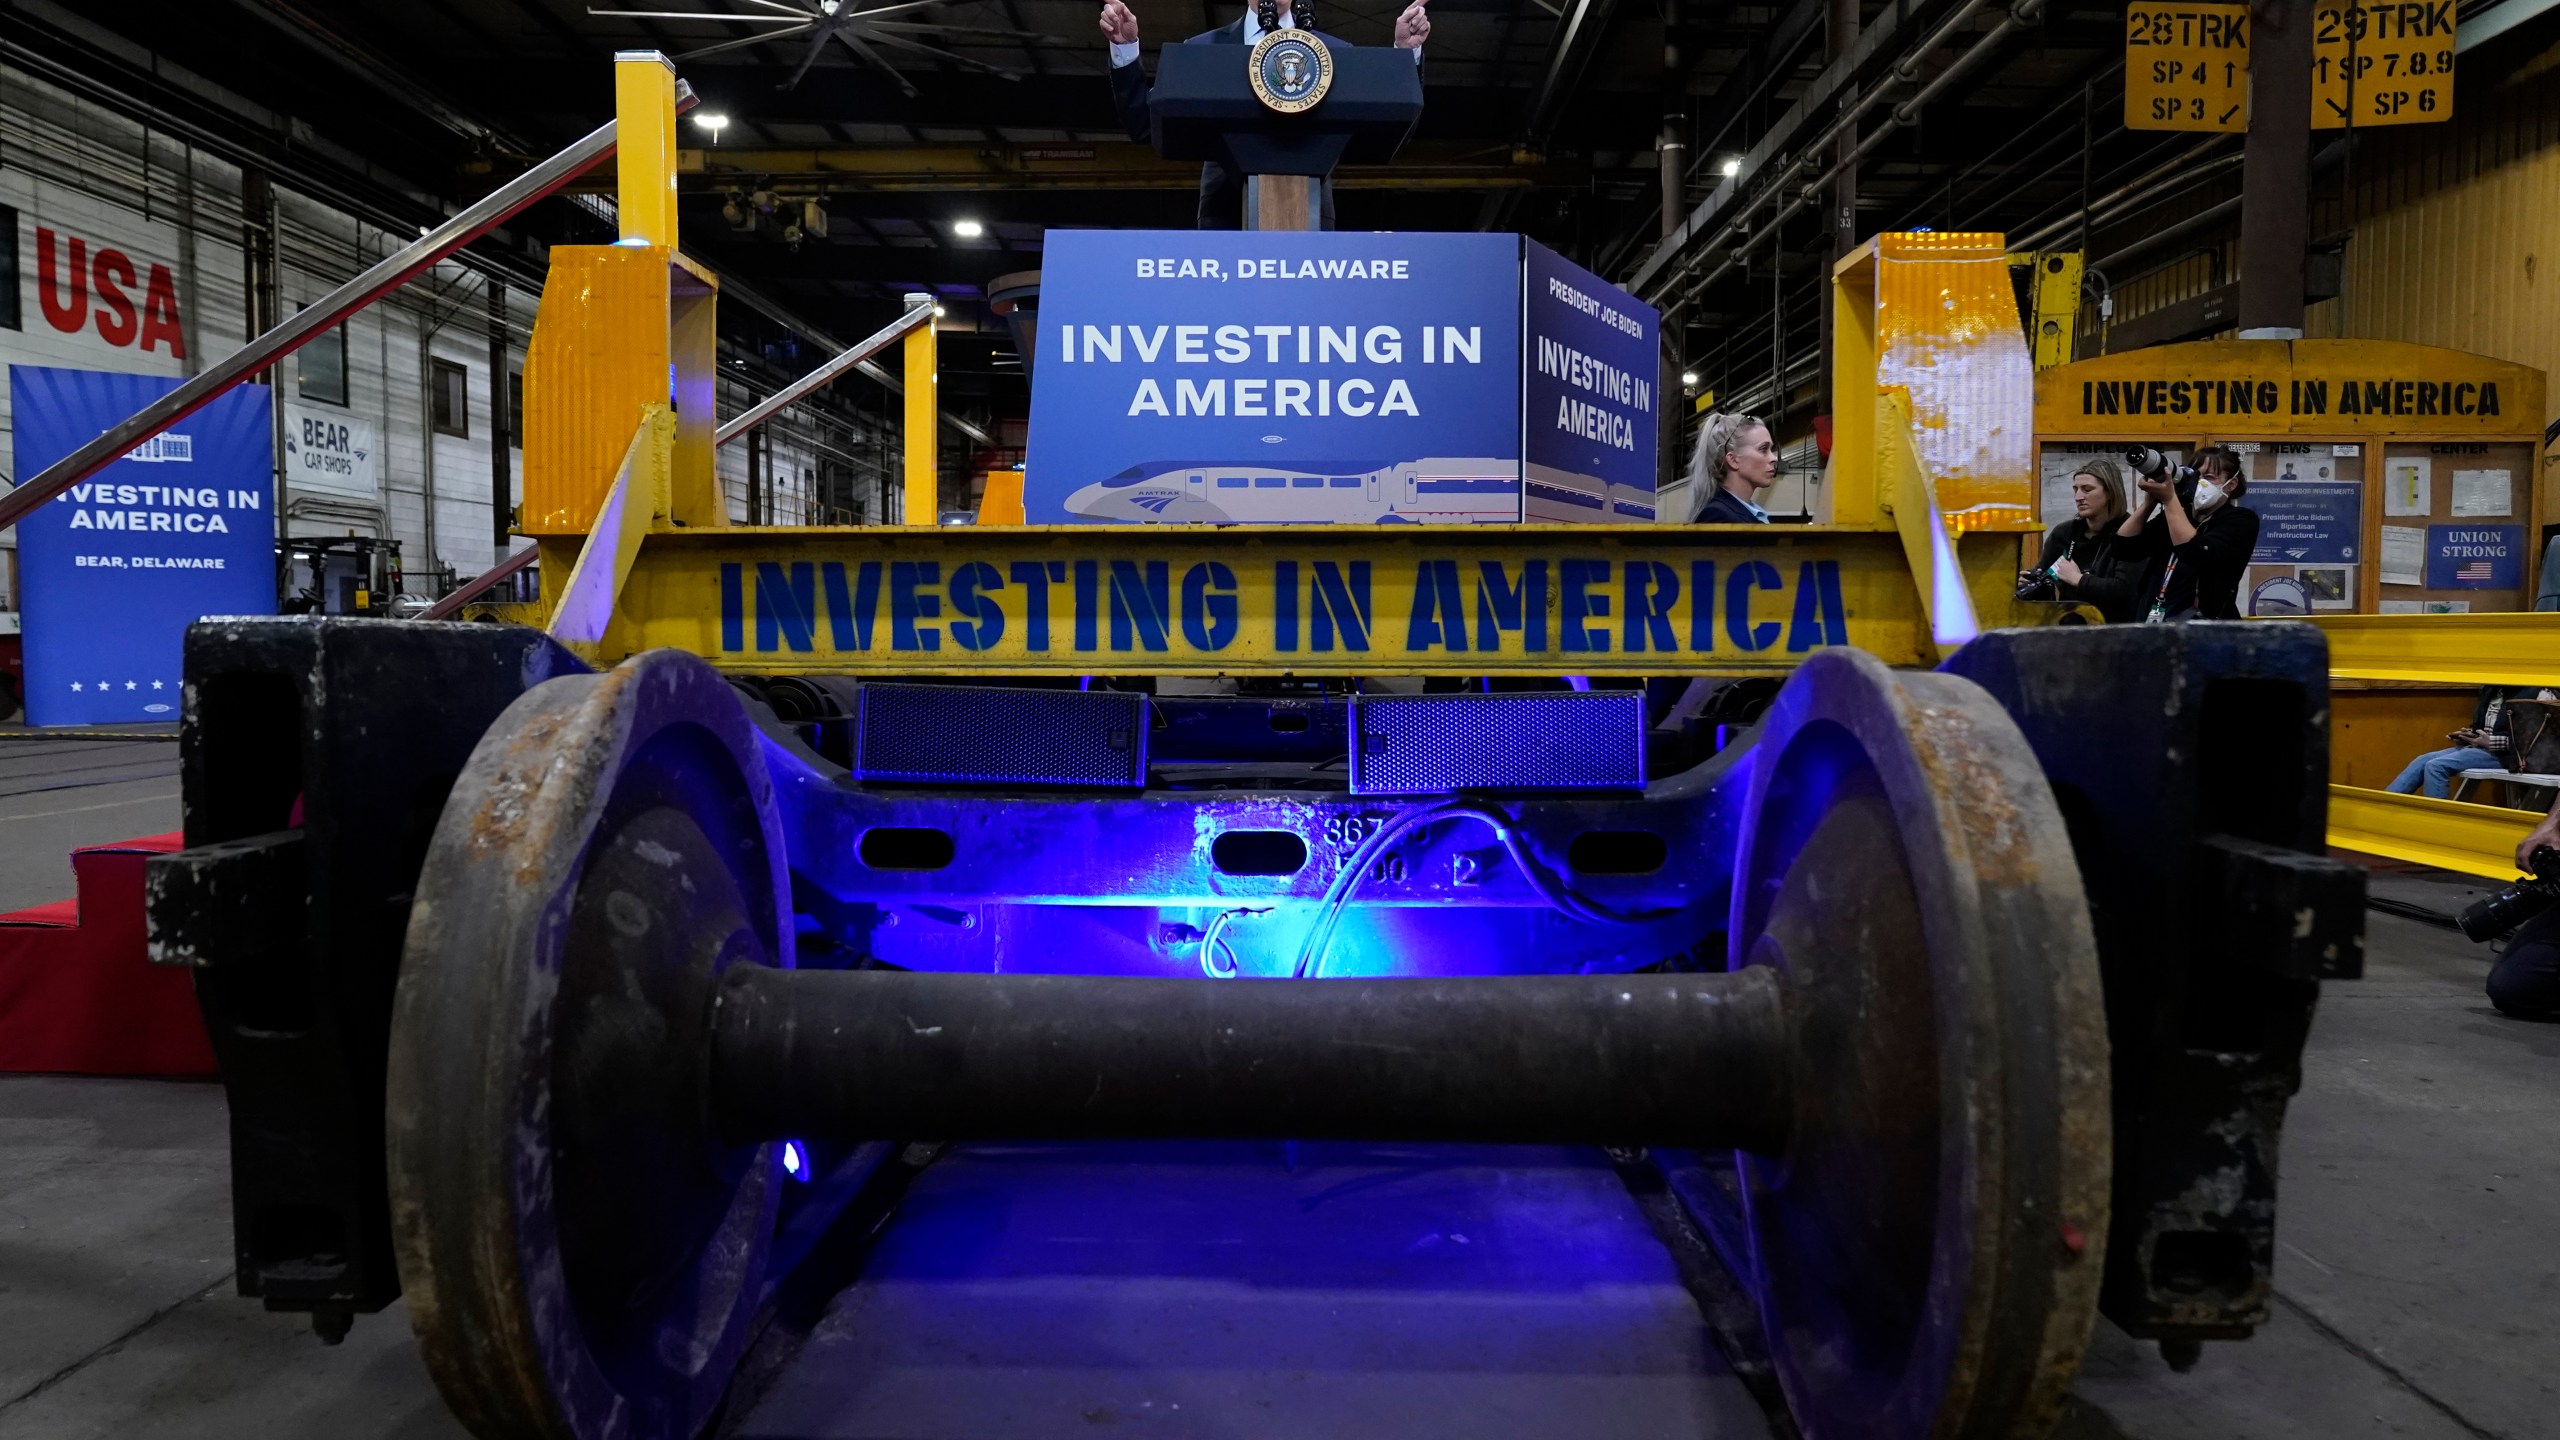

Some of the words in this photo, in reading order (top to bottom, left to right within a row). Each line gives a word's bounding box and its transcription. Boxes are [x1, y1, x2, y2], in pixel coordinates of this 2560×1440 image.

[1252, 31, 1290, 68] PRESIDENT
[1301, 35, 1312, 44] THE
[1314, 42, 1330, 77] UNITED
[2152, 60, 2183, 84] SP
[2191, 61, 2207, 85] 4
[1263, 92, 1284, 109] SEAL
[1298, 83, 1326, 109] STATES
[2374, 91, 2410, 116] SP
[2418, 88, 2436, 113] 6
[2152, 97, 2182, 121] SP
[2190, 97, 2205, 121] 3
[1136, 258, 1229, 283] BEAR,
[1238, 259, 1410, 279] DELAWARE
[35, 226, 187, 359] USA
[1549, 277, 1600, 318] PRESIDENT
[1601, 304, 1618, 328] JOE
[1618, 312, 1643, 340] BIDEN
[1062, 324, 1402, 364] INVESTING
[1422, 326, 1481, 364] IN
[1538, 335, 1631, 406] INVESTING
[1634, 377, 1650, 413] IN
[1127, 378, 1420, 417] AMERICA
[2083, 380, 2278, 415] INVESTING
[2291, 380, 2327, 415] IN
[2338, 381, 2500, 416] AMERICA
[1557, 395, 1634, 451] AMERICA
[303, 417, 350, 455] BEAR
[2270, 443, 2311, 454] NEWS
[2431, 442, 2489, 454] CENTER
[305, 451, 322, 470] CAR
[324, 455, 352, 475] SHOPS
[56, 483, 219, 508] VESTING
[228, 489, 260, 509] IN
[69, 509, 229, 534] AMERICA
[2262, 513, 2295, 521] President
[2281, 522, 2315, 531] Bipartisan
[2267, 531, 2313, 539] Infrastructure
[2448, 531, 2502, 543] UNION
[75, 555, 128, 569] BEAR,
[131, 556, 225, 569] DELAWARE
[2442, 546, 2507, 557] STRONG
[2258, 577, 2283, 593] PRESIDENT
[721, 559, 1239, 652] INVESTING
[1274, 560, 1371, 652] IN
[1405, 559, 1849, 653] AMERICA
